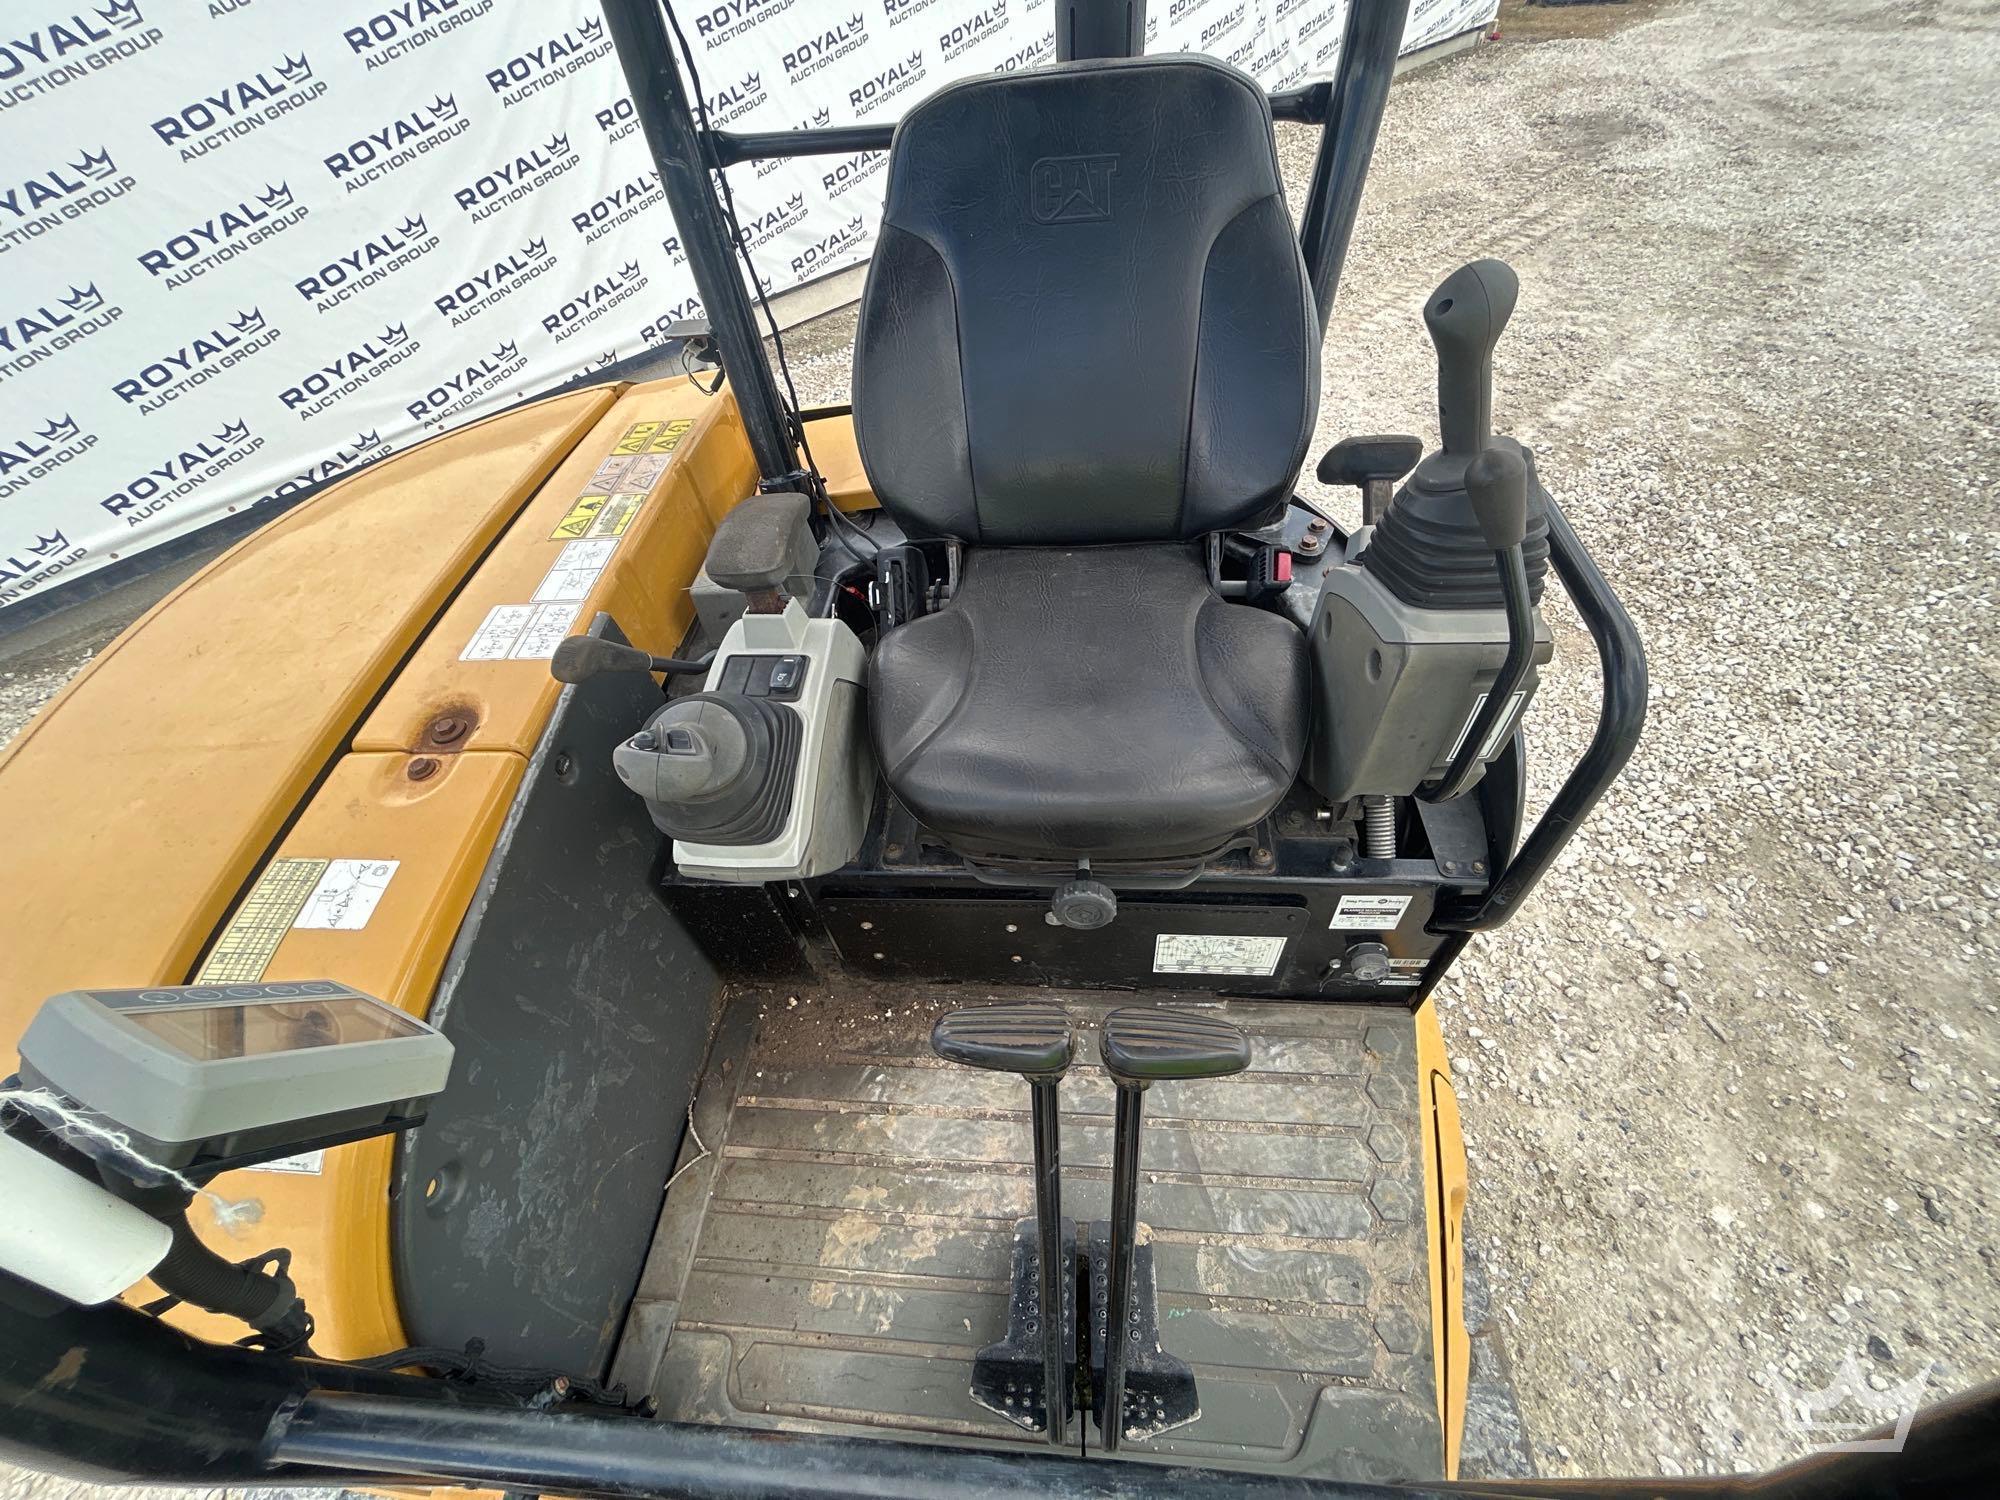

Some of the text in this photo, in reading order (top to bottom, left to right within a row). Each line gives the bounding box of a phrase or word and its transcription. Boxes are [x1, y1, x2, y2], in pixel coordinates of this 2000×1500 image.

[366, 0, 493, 71] AUCTION GROUP
[696, 0, 771, 36] ROYA
[707, 16, 756, 51] AUCTION
[890, 0, 929, 28] AUCTION
[940, 10, 994, 52] ROYAL
[944, 18, 1009, 63] AUCTION GROUP
[1201, 12, 1236, 43] ROYAL
[1299, 11, 1327, 38] ROYAL
[0, 16, 112, 80] OYAL
[0, 28, 163, 111] UCTION GROUP
[486, 33, 583, 94] ROYAL
[502, 41, 613, 108] AUCTION GROUP
[782, 26, 849, 73] ROYAL
[791, 33, 868, 86] AUCTION GROUP
[150, 74, 287, 146] ROYAL
[730, 92, 767, 120] GROUP
[849, 63, 909, 107] ROYAL
[855, 69, 926, 118] AUCTION GROUP
[180, 81, 328, 163] AUCTION GROUP
[323, 112, 436, 178] ROYAL
[609, 119, 640, 145] AUCT
[346, 118, 470, 194] AUCTION GROUP
[454, 150, 552, 211] ROYAL
[829, 170, 868, 200] AUCTION
[60, 176, 136, 219] GROUP
[472, 154, 580, 224] AUCTION GROUP
[571, 177, 655, 233] ROYAL
[586, 190, 664, 245] AUCTION GRO
[137, 203, 269, 276] ROYAL
[165, 206, 309, 291] AUCTION GROUP
[741, 206, 789, 242] OYAL
[776, 209, 808, 234] GROUP
[791, 229, 851, 273] ROYAL
[295, 234, 406, 301] ROYAL
[317, 236, 440, 314] AUCTION GROUP
[434, 255, 529, 316] ROYAL
[798, 230, 868, 282] AUCTION GROUP
[452, 256, 557, 328] AUCTION GROUP
[541, 277, 624, 334] ROYAL
[555, 304, 608, 344] AUCTION
[608, 277, 648, 308] GROUP
[640, 296, 700, 343] ROYA
[0, 307, 123, 377] TION GROUP
[112, 330, 242, 404] ROYAL
[139, 329, 281, 416] AUCTION GROUP
[278, 343, 388, 410] ROYAL
[300, 342, 420, 421] AUCTION GROUP
[406, 359, 500, 421] ROYAL
[424, 387, 484, 429] AUCTION
[483, 357, 528, 390] GROUP
[27, 435, 98, 479] GROUP
[100, 442, 226, 516] ROYAL
[127, 437, 264, 527] AUCTION GROUP
[19, 548, 88, 590] GROUP
